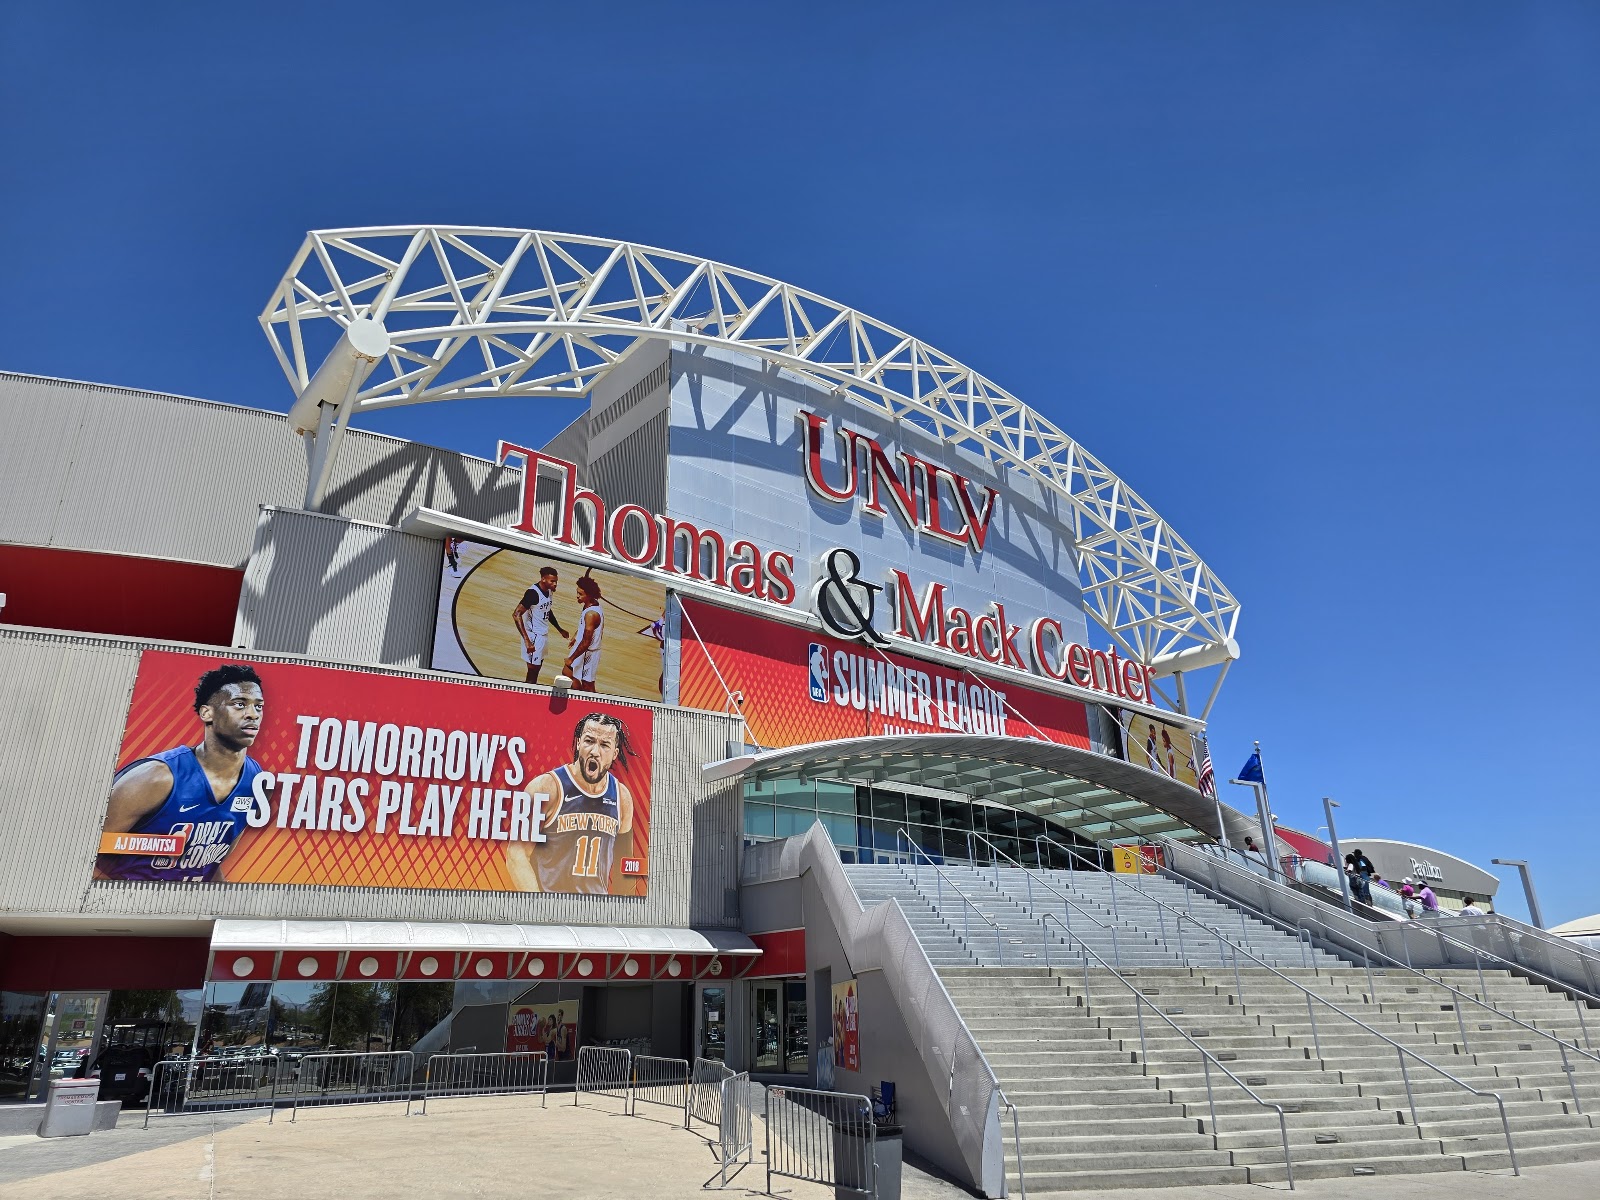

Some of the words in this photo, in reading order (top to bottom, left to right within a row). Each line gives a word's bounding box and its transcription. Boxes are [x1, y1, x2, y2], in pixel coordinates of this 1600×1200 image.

[794, 408, 1000, 553] UNLV
[496, 439, 796, 606] Thomas
[811, 547, 892, 648] &
[888, 567, 1029, 672] Mack
[1031, 616, 1156, 706] Center
[833, 650, 934, 725] SUMMER
[936, 675, 1008, 736] LEAGUE
[296, 715, 526, 786] TOMORROW'S
[246, 771, 370, 833] STARS
[375, 780, 463, 837] PLAY
[467, 787, 550, 843] HERE
[556, 812, 593, 834] NEW
[591, 813, 618, 838] YORK
[114, 836, 128, 850] AJ
[128, 837, 176, 852] DYBANTSA
[572, 835, 602, 877] 11
[624, 860, 640, 873] 2018
